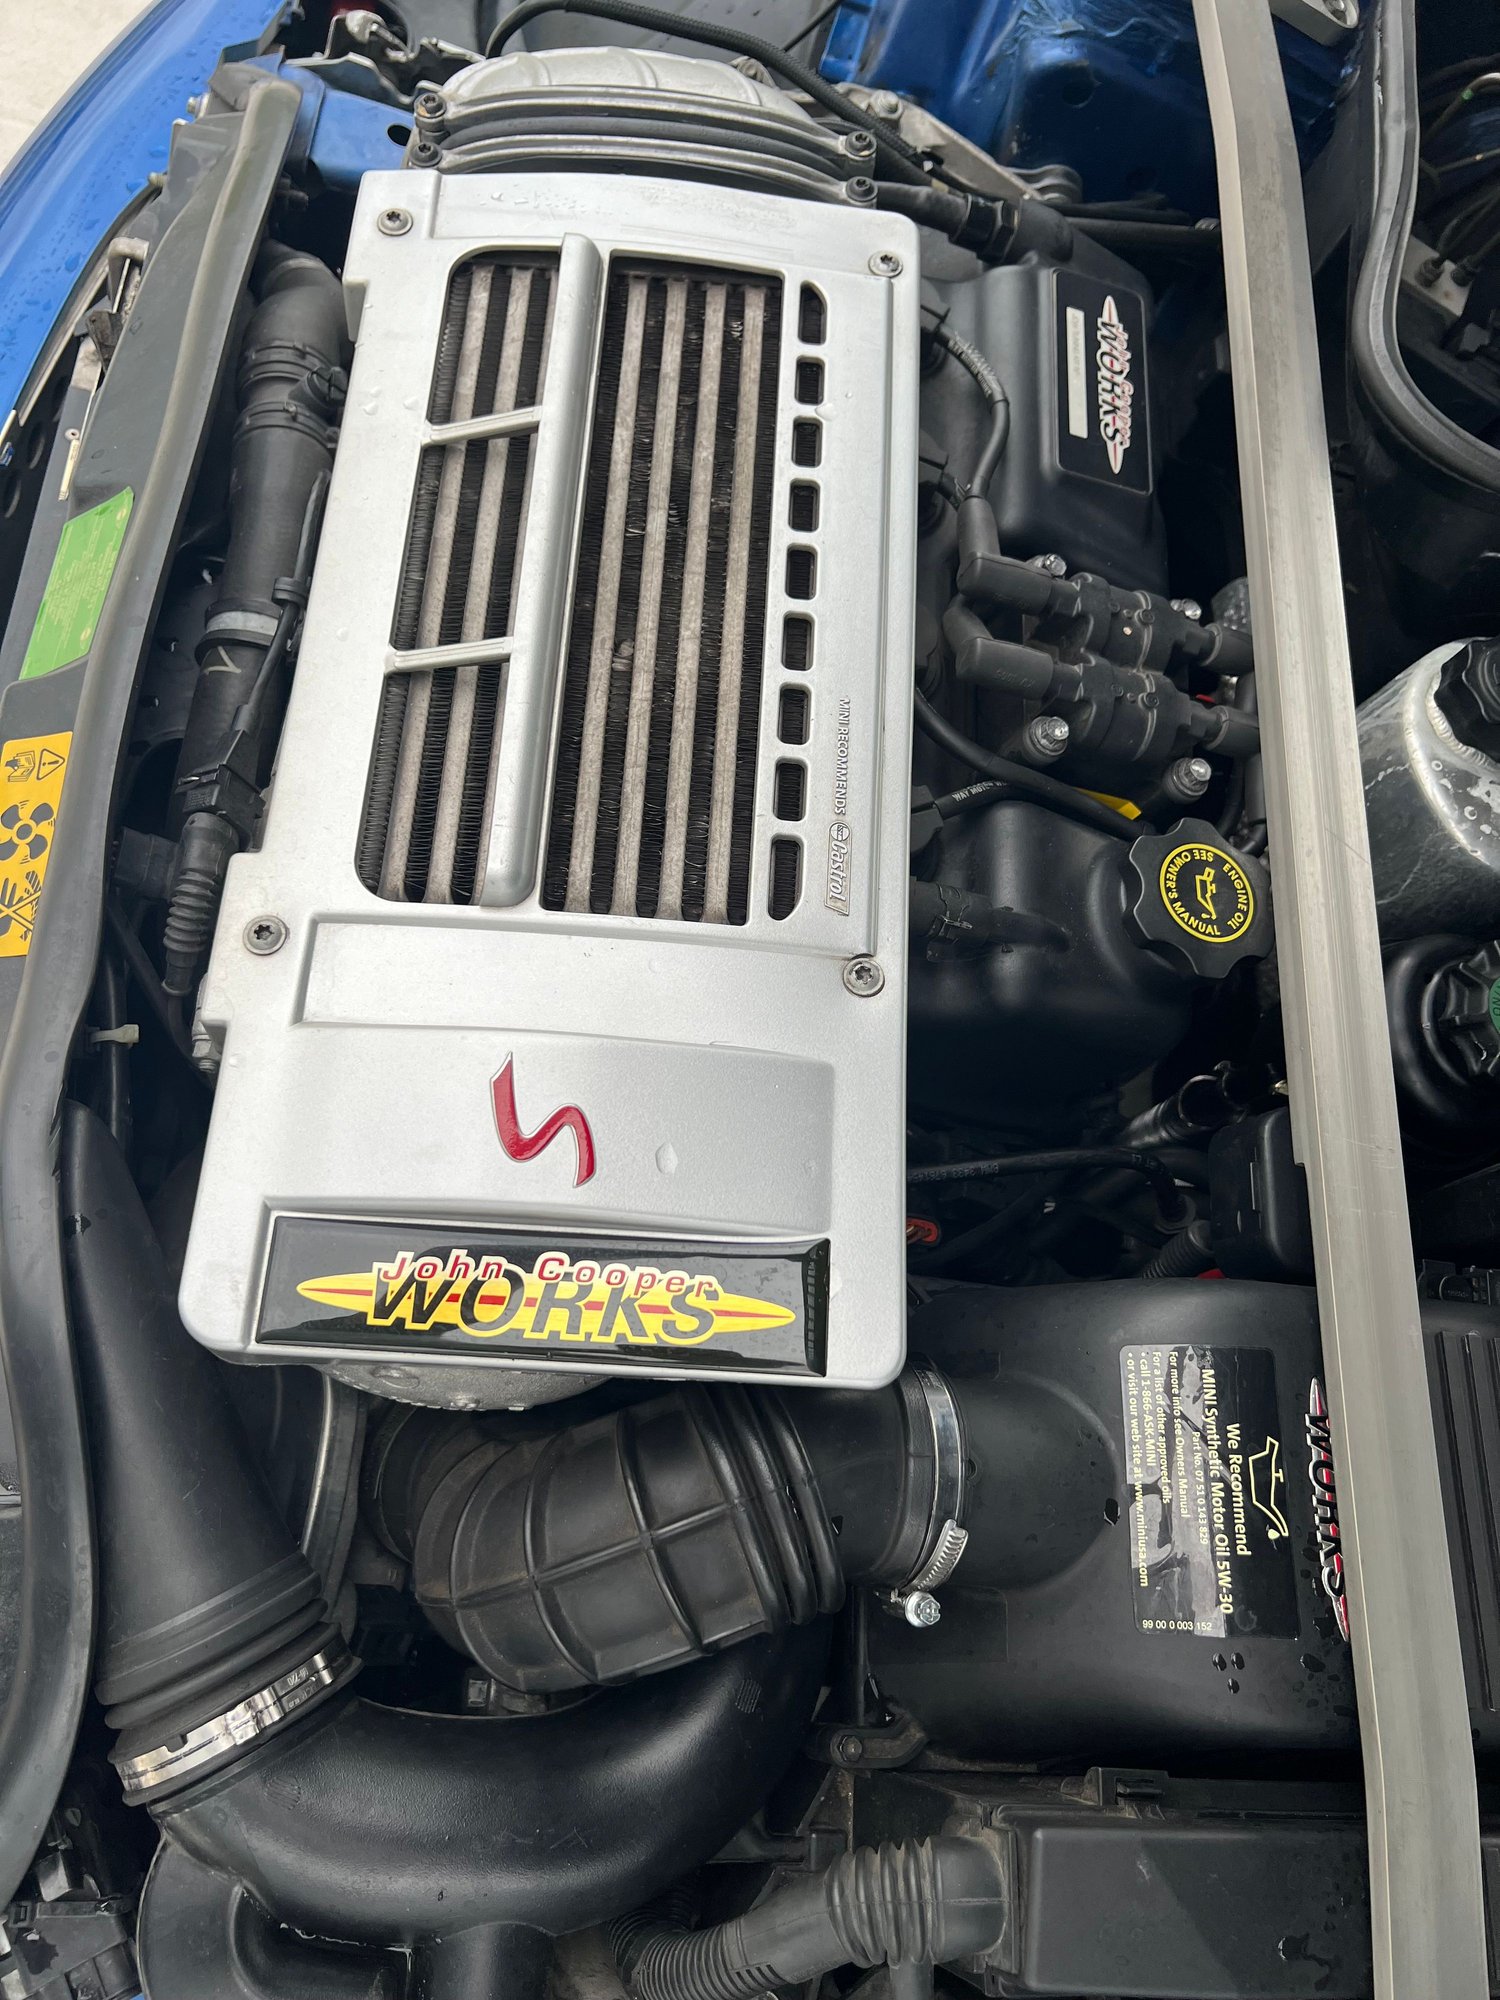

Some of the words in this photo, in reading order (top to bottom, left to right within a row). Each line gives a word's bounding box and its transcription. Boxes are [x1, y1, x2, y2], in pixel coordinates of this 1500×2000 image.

[1098, 318, 1124, 446] WORKS
[838, 697, 850, 725] MINI
[834, 727, 849, 815] RECOMMENDS
[1192, 849, 1214, 862] SEE
[829, 840, 848, 902] Castrol
[1165, 851, 1191, 899] OWNER'S
[1222, 863, 1247, 912] ENGINE
[1172, 901, 1221, 936] MANUAL
[1227, 912, 1244, 930] OIL
[382, 1252, 503, 1282] John
[537, 1256, 717, 1299] Cooper
[372, 1266, 720, 1342] WORKS
[1127, 1360, 1135, 1370] or
[1140, 1359, 1151, 1377] call
[1152, 1351, 1162, 1366] For
[1169, 1351, 1179, 1366] For
[1128, 1372, 1138, 1396] visit
[1154, 1377, 1165, 1393] list
[1170, 1368, 1180, 1395] more
[1201, 1369, 1217, 1405] MINI
[1129, 1398, 1138, 1417] our
[1155, 1394, 1166, 1406] of
[1172, 1396, 1182, 1417] info
[1130, 1418, 1142, 1442] web
[1141, 1380, 1157, 1467] 1-866-ASK-MINI
[1156, 1407, 1167, 1434] other
[1192, 1431, 1202, 1450] Part
[1202, 1408, 1224, 1478] Synthetic
[1226, 1423, 1241, 1450] We
[1132, 1443, 1143, 1465] site
[1156, 1436, 1171, 1484] approved
[1175, 1437, 1185, 1476] Owners
[1193, 1452, 1202, 1467] No.
[1133, 1467, 1143, 1479] at
[1195, 1470, 1204, 1483] 07
[1161, 1485, 1172, 1504] oils
[1178, 1478, 1191, 1518] Manual
[1196, 1485, 1205, 1496] 51
[1197, 1507, 1207, 1524] 143
[1211, 1483, 1227, 1531] Motor
[1228, 1454, 1252, 1556] Recommend
[1134, 1481, 1149, 1587] www.miniusa.com
[1199, 1526, 1209, 1545] 829
[1215, 1533, 1231, 1556] Oil
[1216, 1561, 1234, 1614] 5W-30
[1142, 1619, 1154, 1629] 99
[1155, 1619, 1167, 1630] 00
[1168, 1620, 1176, 1630] 0
[1176, 1620, 1194, 1631] 003
[1196, 1621, 1213, 1631] 152
